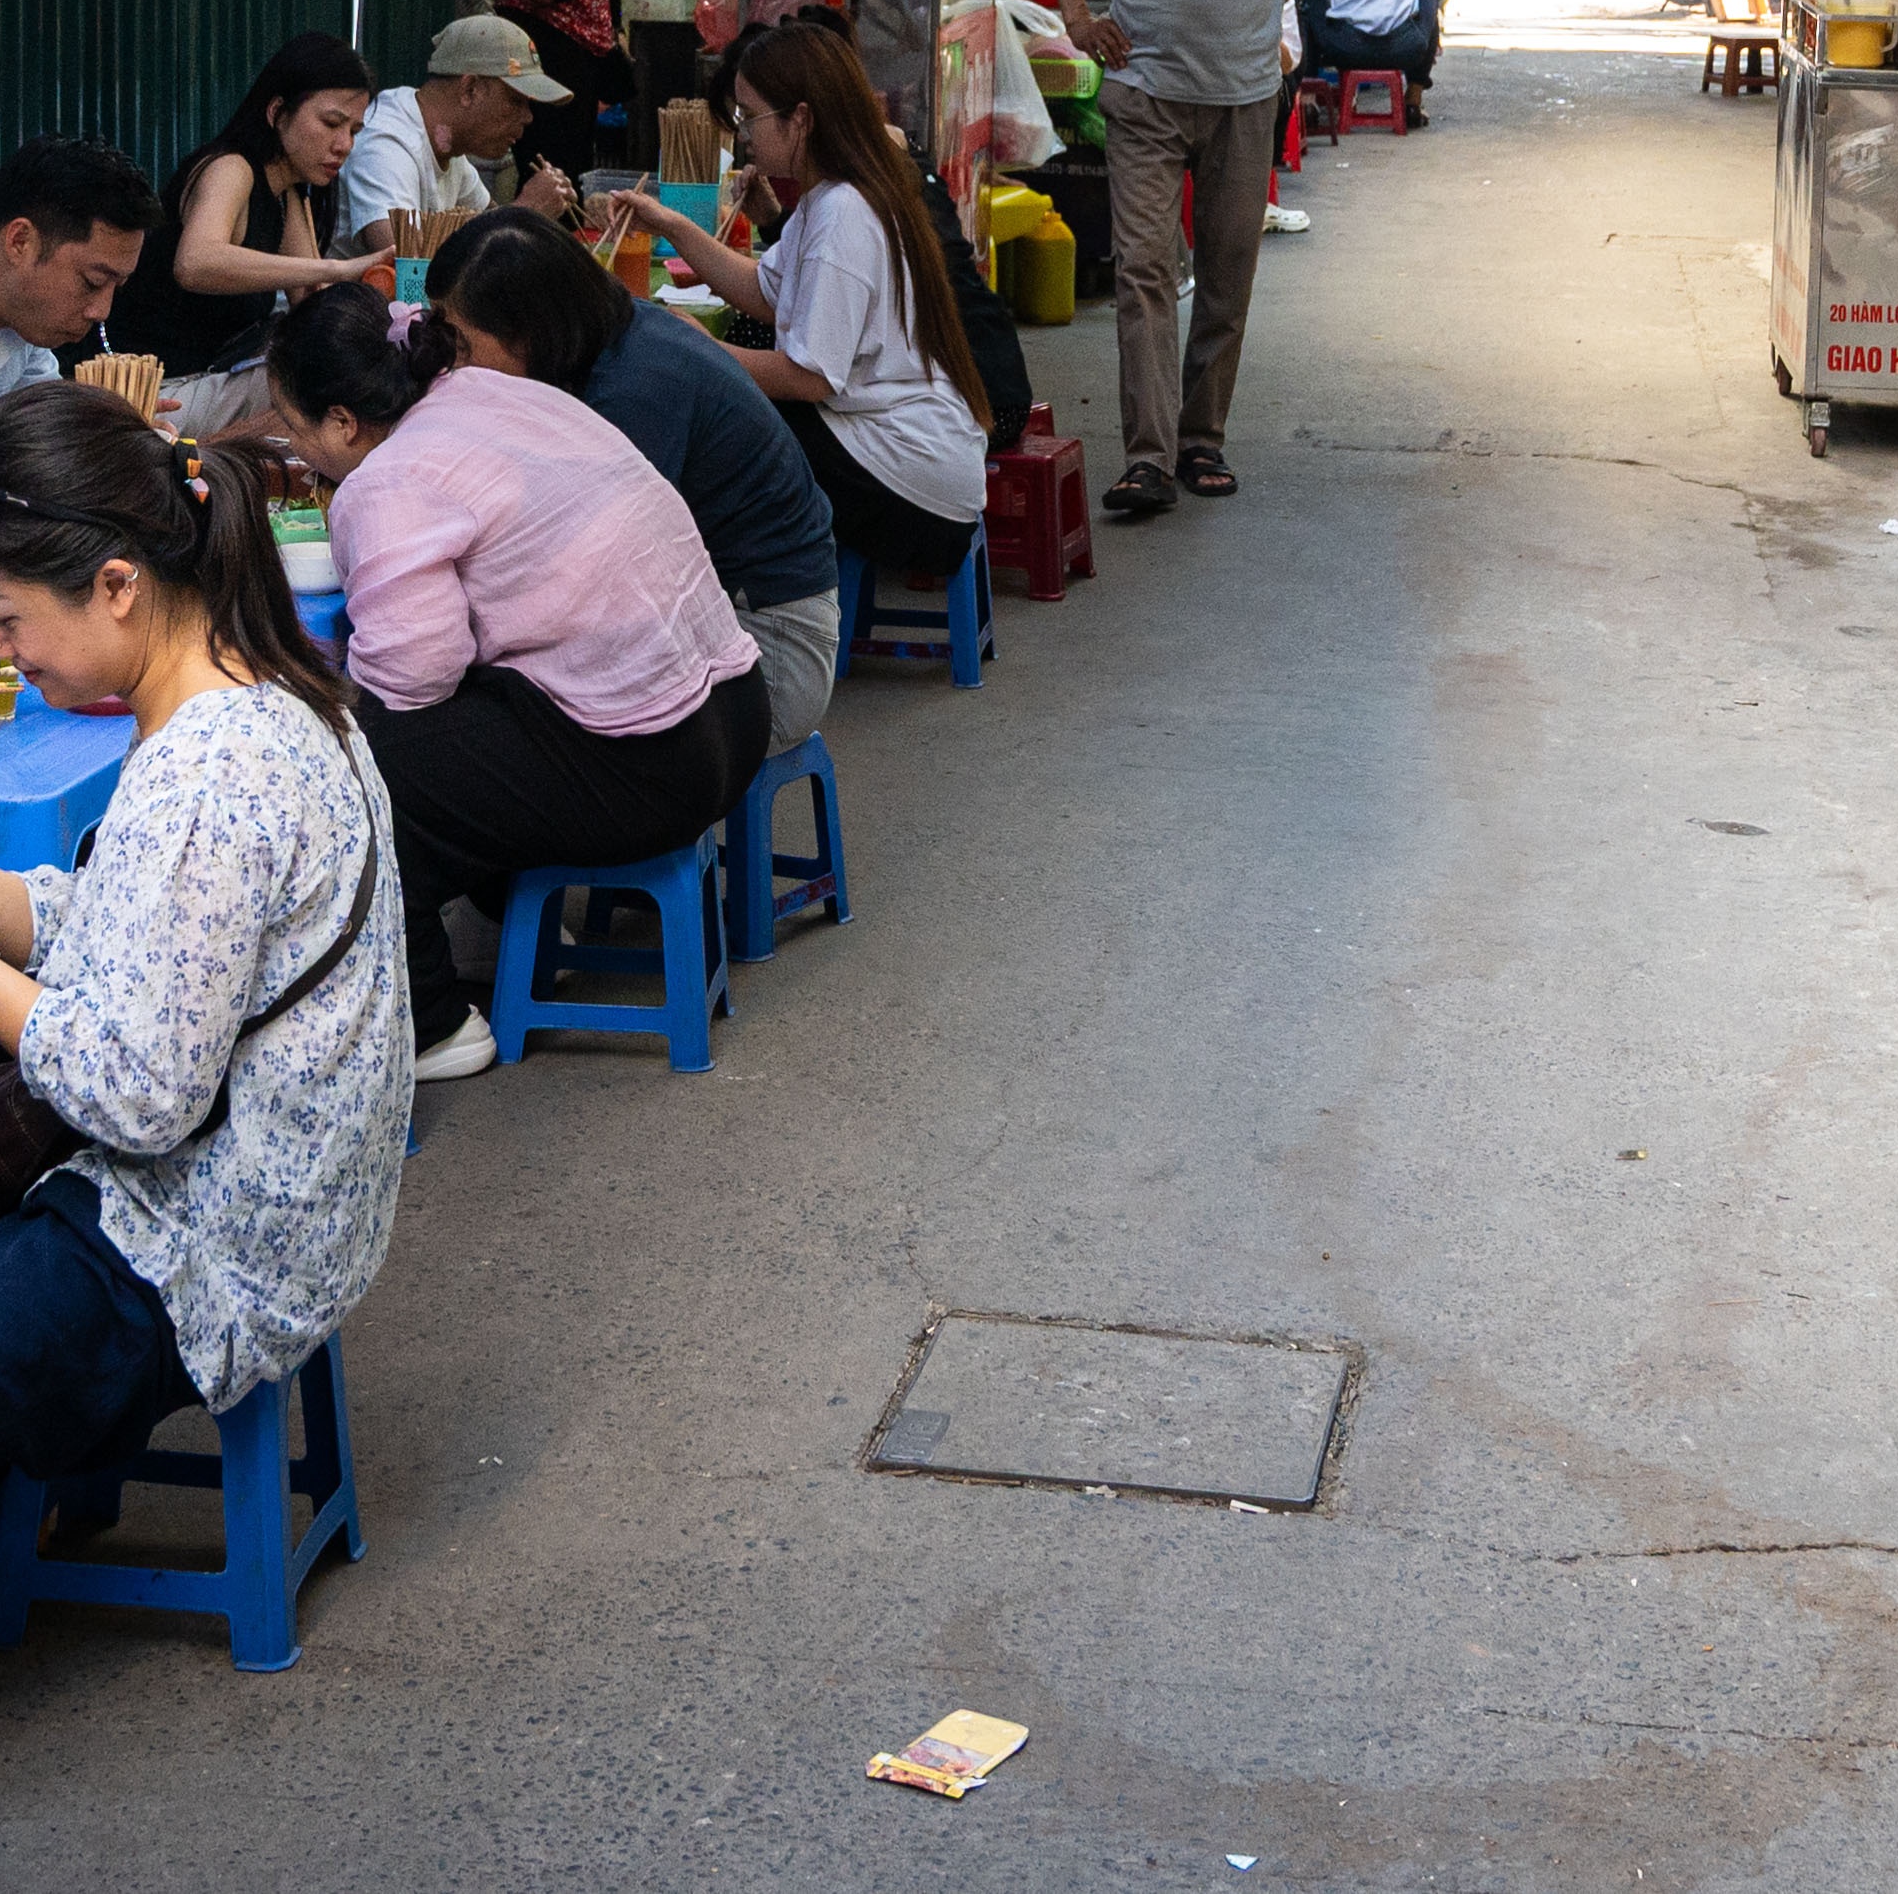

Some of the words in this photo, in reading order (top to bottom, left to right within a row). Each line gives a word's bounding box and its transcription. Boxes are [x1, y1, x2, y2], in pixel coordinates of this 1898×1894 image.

[1829, 304, 1847, 323] 20
[1851, 301, 1883, 324] HÀM
[1827, 344, 1883, 373] GIAO
